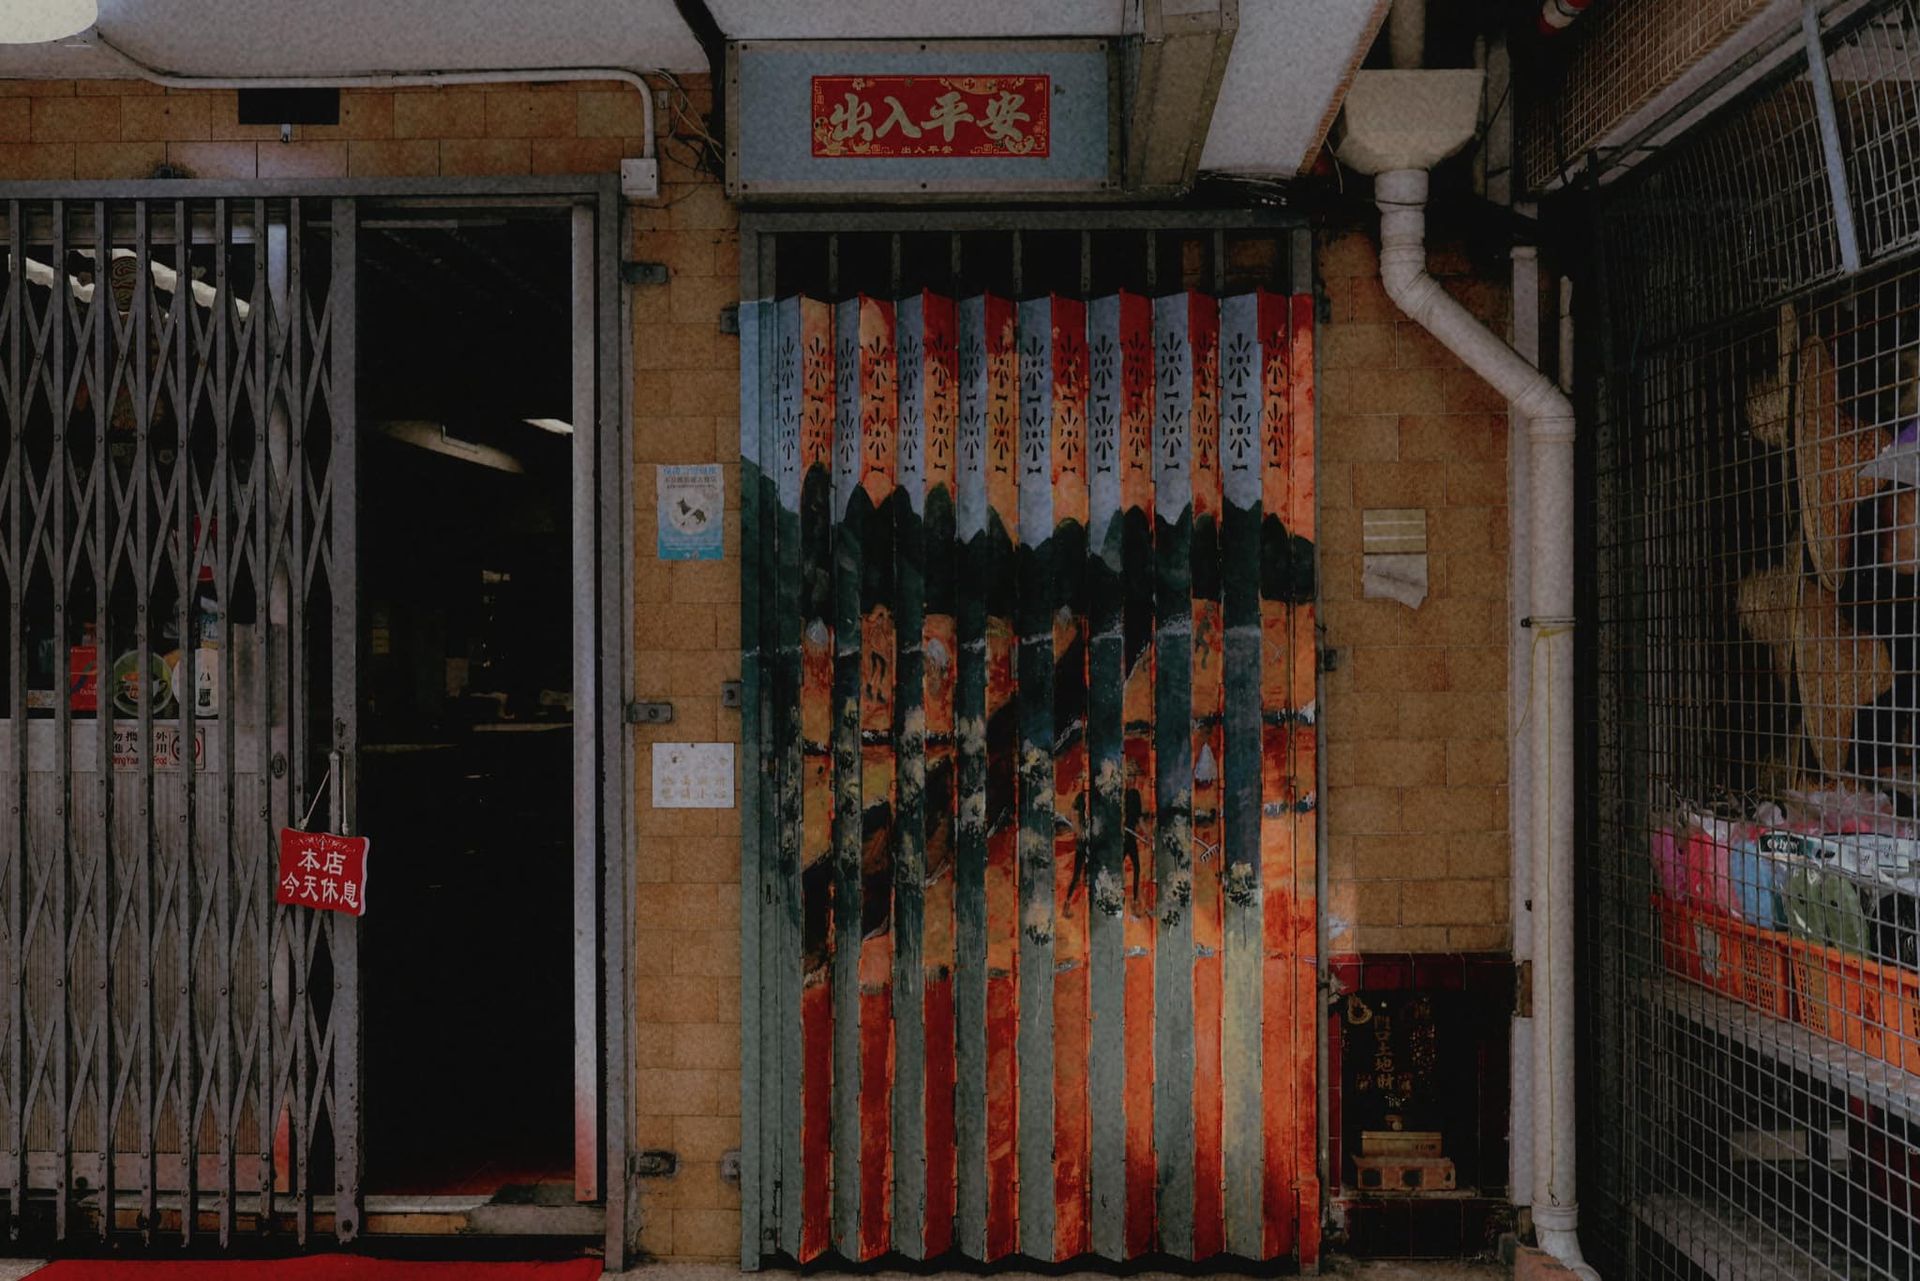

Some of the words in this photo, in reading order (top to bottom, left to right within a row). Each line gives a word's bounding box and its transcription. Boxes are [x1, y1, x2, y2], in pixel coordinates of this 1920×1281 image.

[830, 91, 1031, 142] 出入平安
[900, 145, 953, 155] 出入平安
[297, 848, 347, 876] 本店
[281, 871, 359, 909] 今天休息
